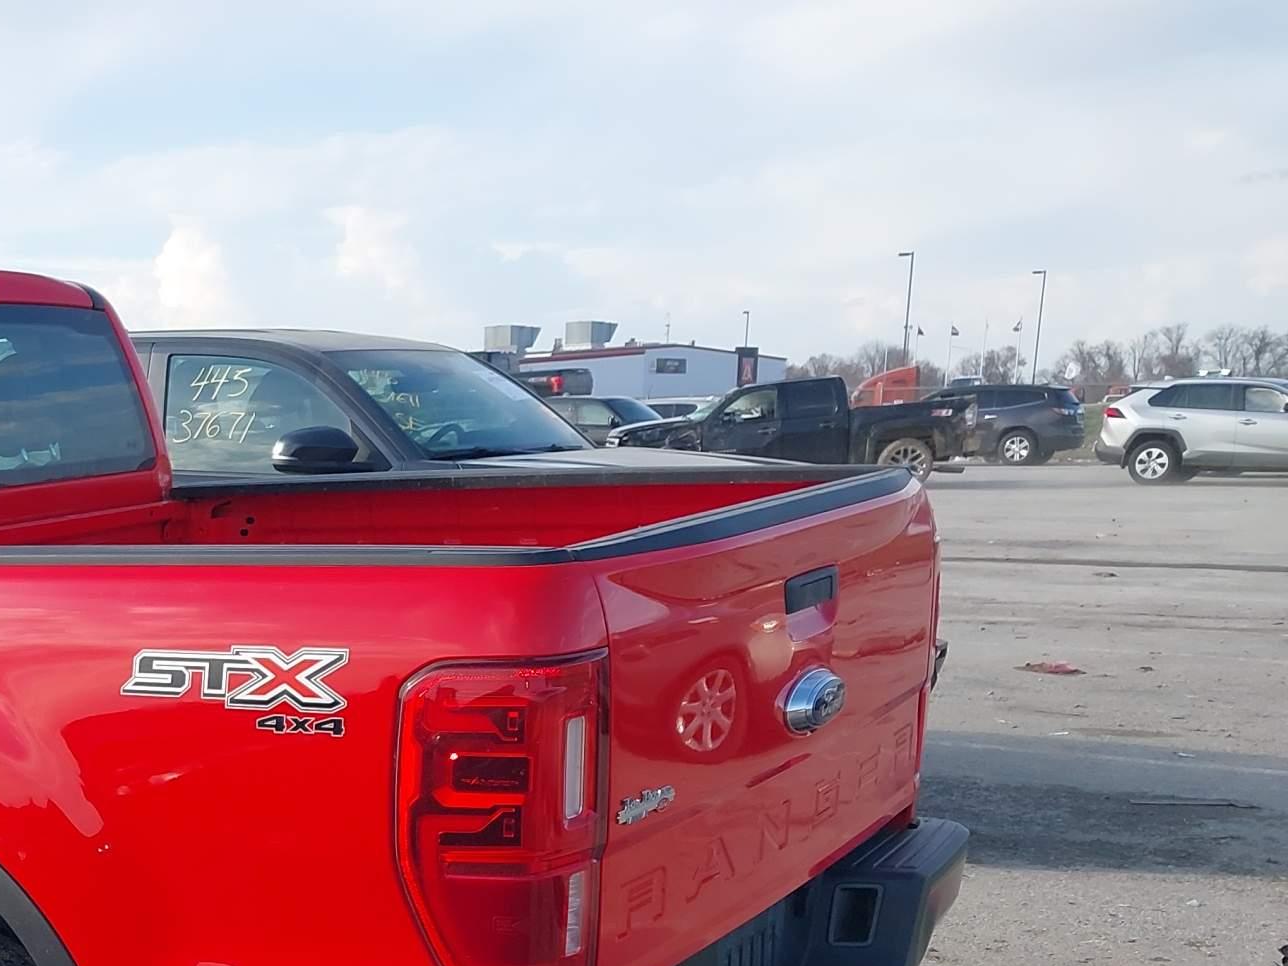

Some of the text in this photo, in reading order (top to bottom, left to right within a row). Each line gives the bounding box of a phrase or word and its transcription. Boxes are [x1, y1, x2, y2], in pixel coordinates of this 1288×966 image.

[190, 365, 252, 400] 445
[172, 409, 256, 444] 37671
[120, 644, 350, 714] STX
[616, 721, 914, 940] RANGER
